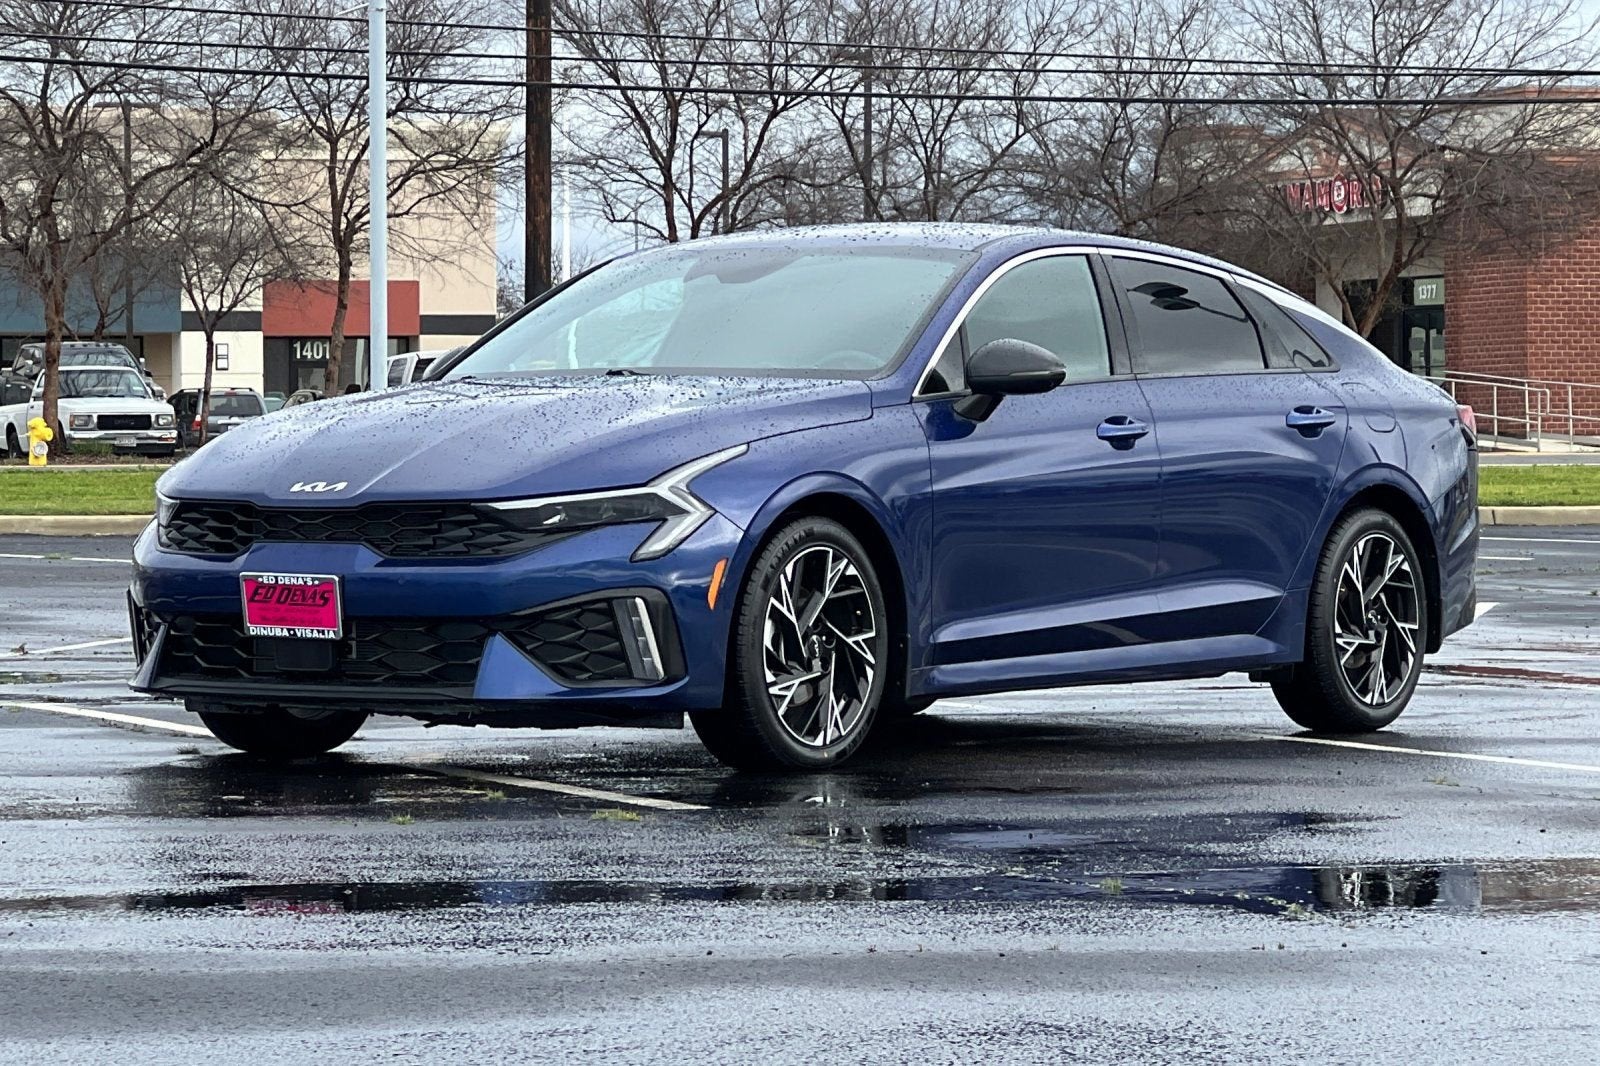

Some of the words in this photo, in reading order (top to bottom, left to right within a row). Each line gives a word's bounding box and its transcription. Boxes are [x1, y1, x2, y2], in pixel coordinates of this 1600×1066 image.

[1418, 284, 1437, 300] 1377
[293, 341, 330, 359] 1401
[263, 576, 275, 584] ED
[278, 577, 313, 585] DENA'S
[249, 585, 277, 603] ED
[249, 627, 289, 636] DINUBA
